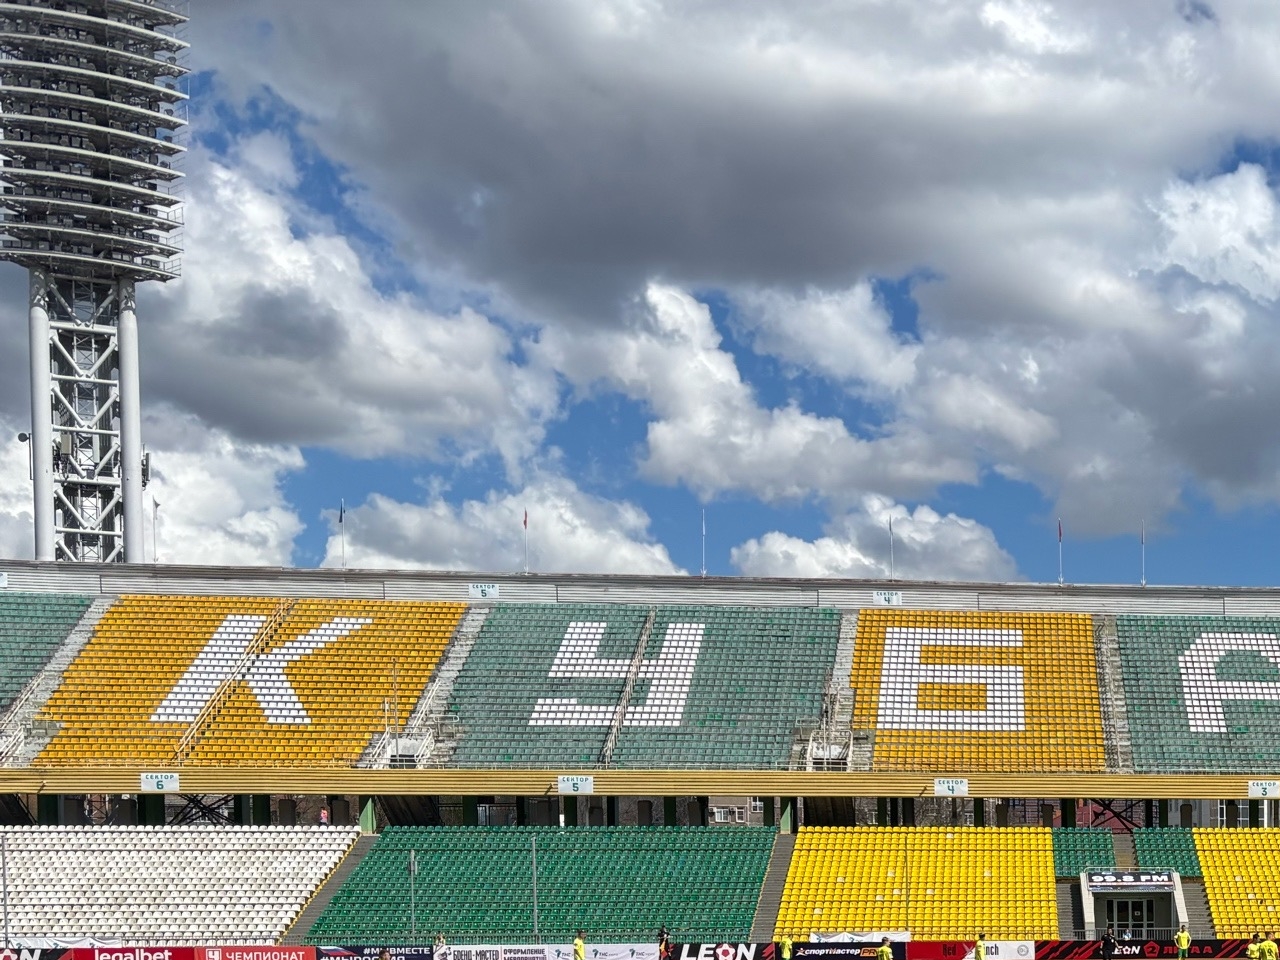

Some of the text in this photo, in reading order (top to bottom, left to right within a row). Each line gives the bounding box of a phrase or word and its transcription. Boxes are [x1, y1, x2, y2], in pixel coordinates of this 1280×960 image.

[156, 780, 164, 790] 6
[572, 782, 579, 792] 5
[947, 785, 955, 794] 4
[1261, 787, 1268, 796] 3
[363, 947, 430, 955] #МВМЕСТЕ
[861, 948, 877, 956] PR
[984, 943, 999, 956] inch
